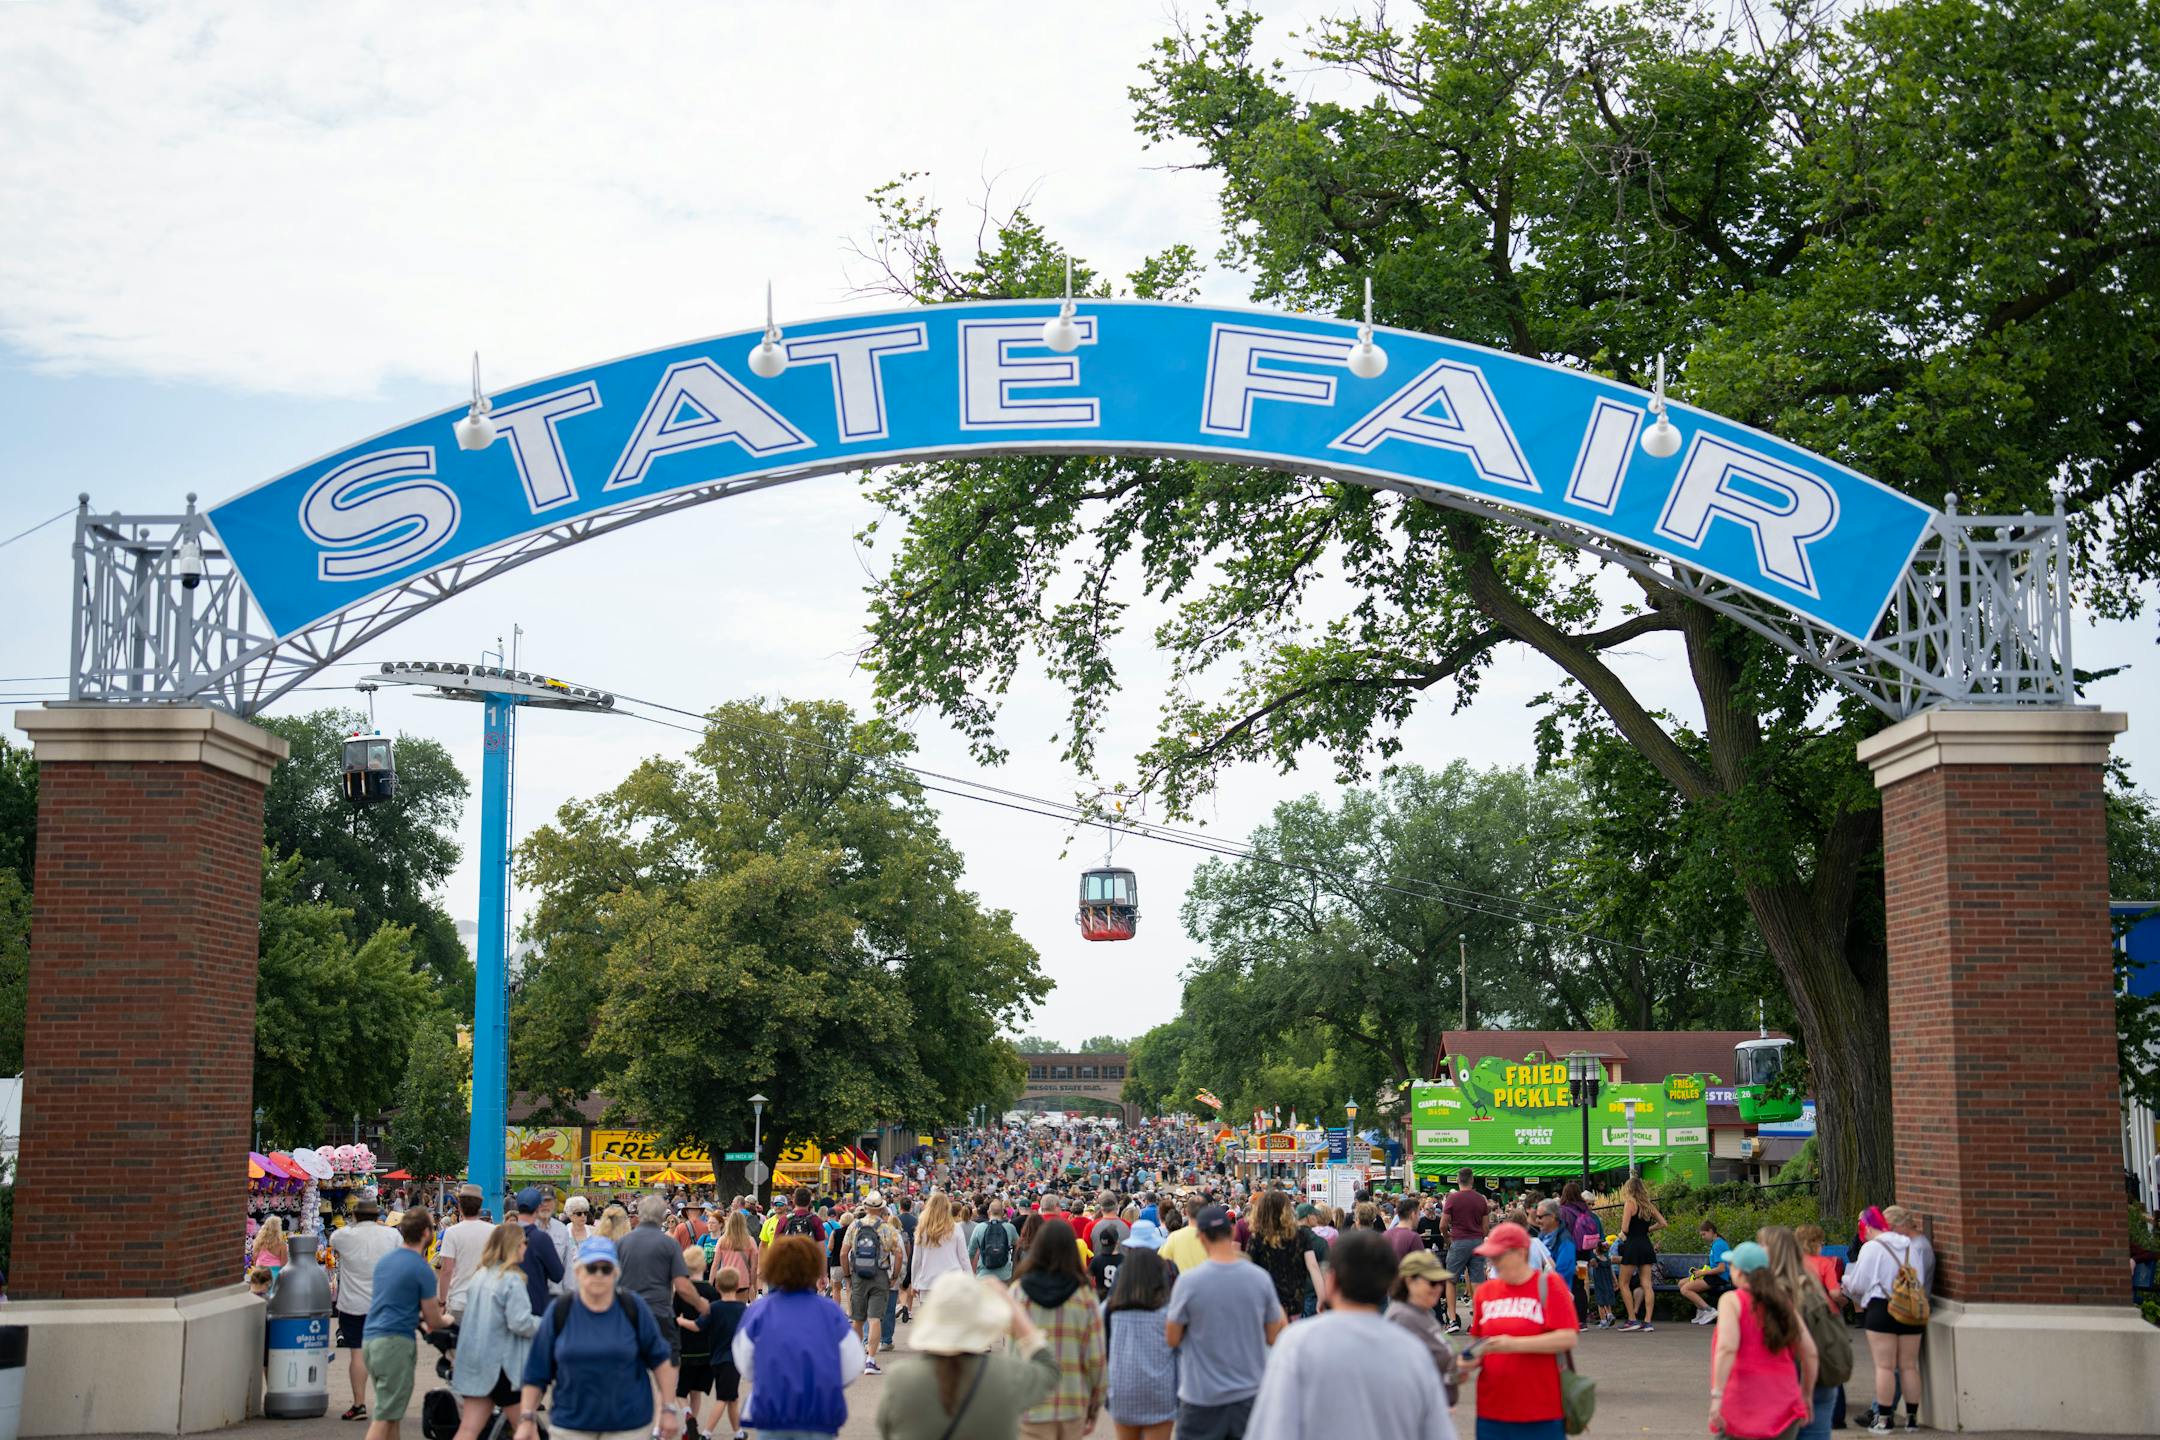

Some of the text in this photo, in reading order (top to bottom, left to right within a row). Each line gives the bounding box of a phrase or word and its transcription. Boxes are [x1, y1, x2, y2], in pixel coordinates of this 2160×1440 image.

[300, 316, 1841, 599] STATE FAIR
[488, 706, 497, 727] 1
[1506, 1065, 1568, 1086] FRIED
[1673, 1079, 1694, 1089] FRIED
[1669, 1089, 1700, 1100] PICKLES
[625, 1131, 659, 1141] FRES
[1515, 1128, 1553, 1136] PERFECT
